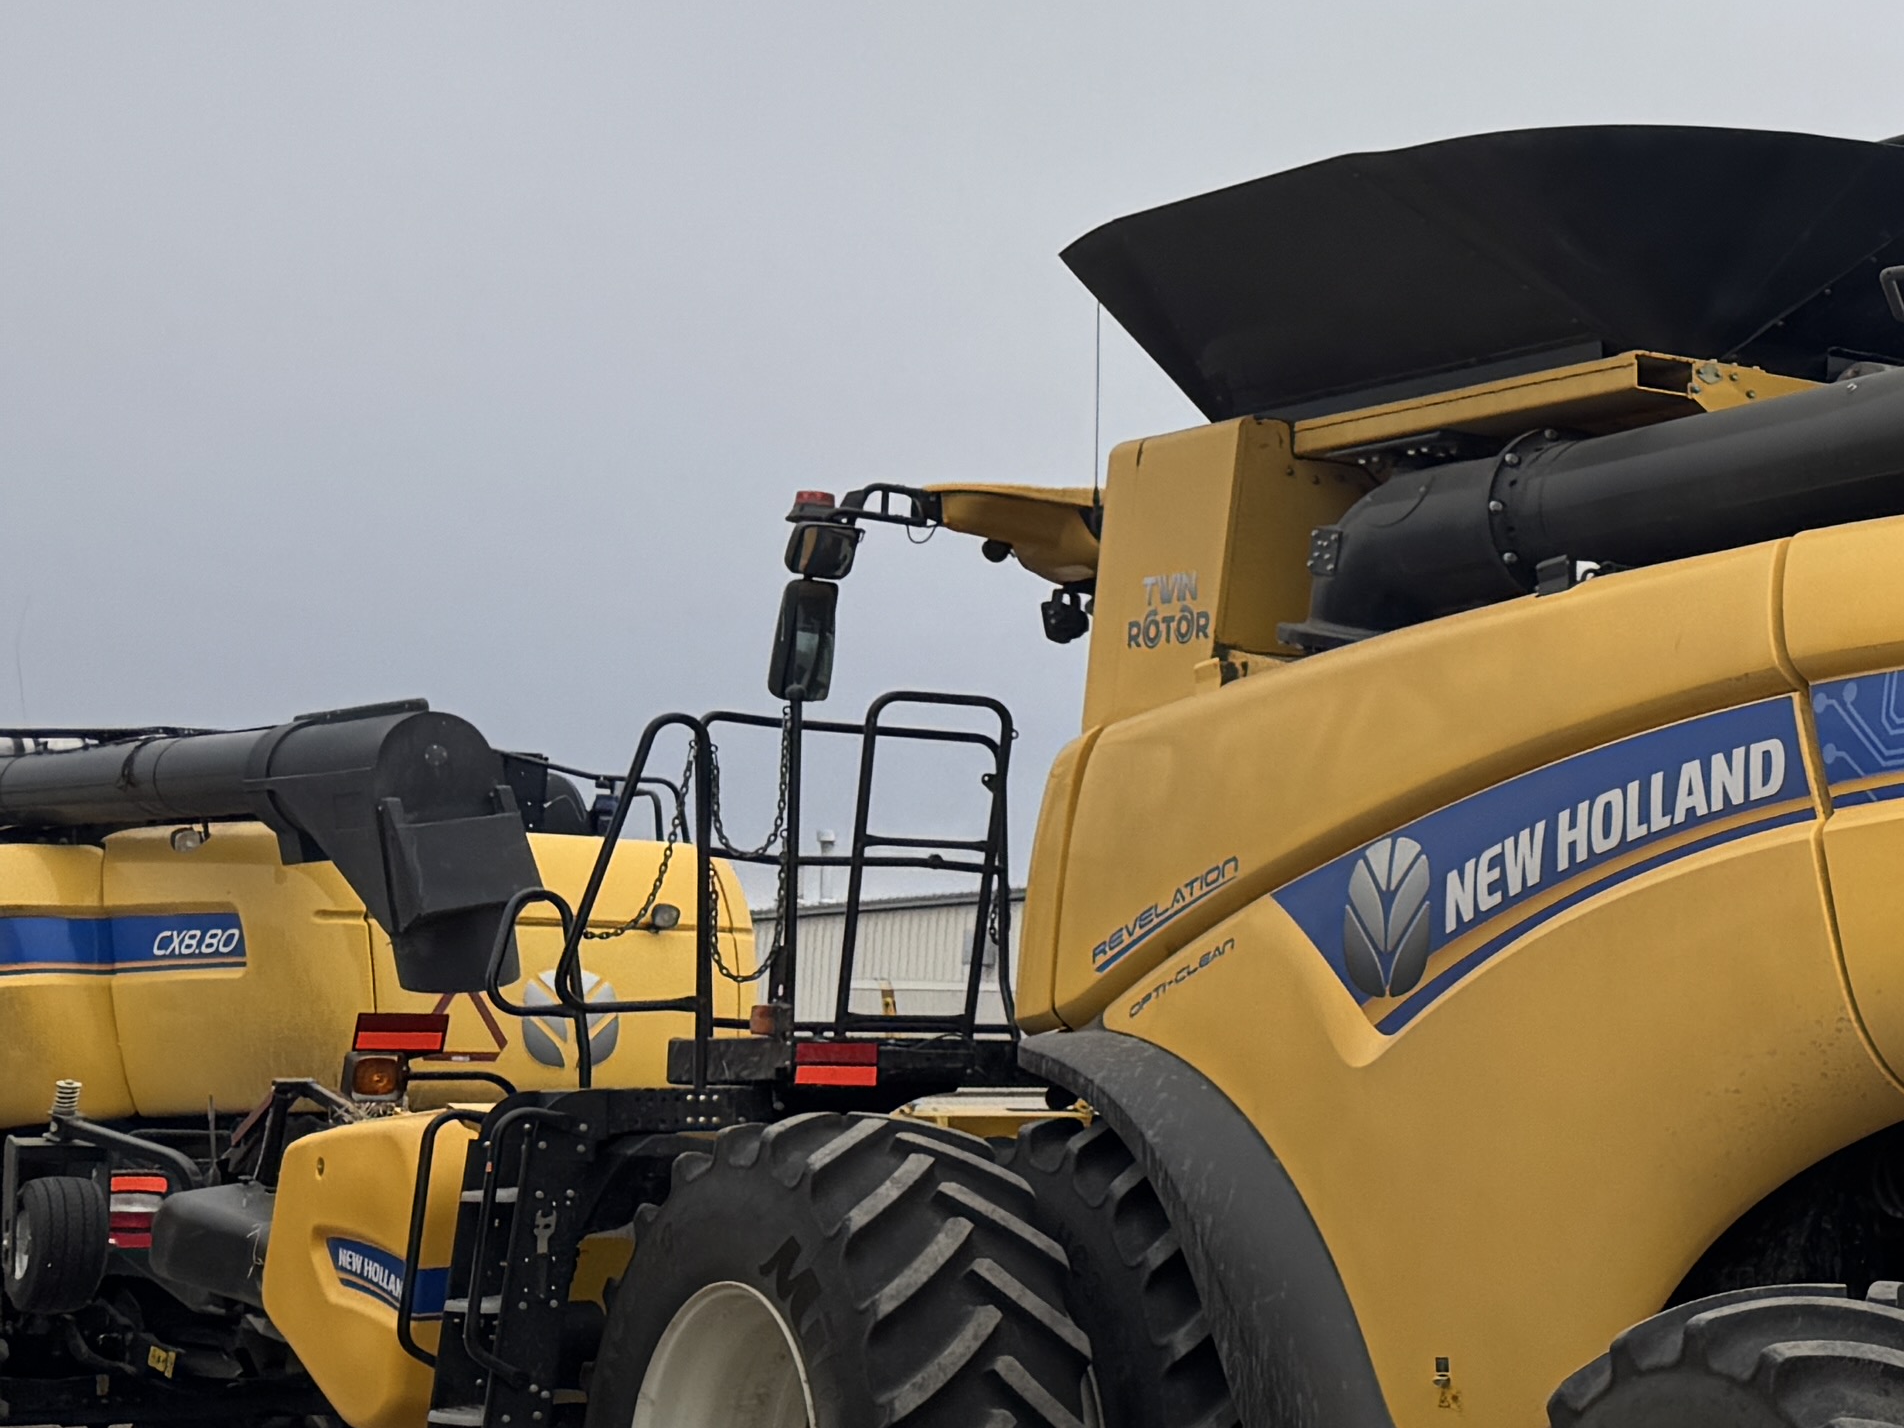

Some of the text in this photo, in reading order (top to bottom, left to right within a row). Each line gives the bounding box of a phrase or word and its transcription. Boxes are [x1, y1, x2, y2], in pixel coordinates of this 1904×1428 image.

[1142, 569, 1198, 606] TWIN
[1127, 605, 1210, 649] ROTOR
[1444, 738, 1787, 933] NEW HOLLAND
[1092, 855, 1239, 964] REVELATION
[153, 928, 239, 956] CX8.80
[1129, 938, 1235, 1018] OPTI-CLEAN
[338, 1247, 403, 1301] NEW HOLLAN
